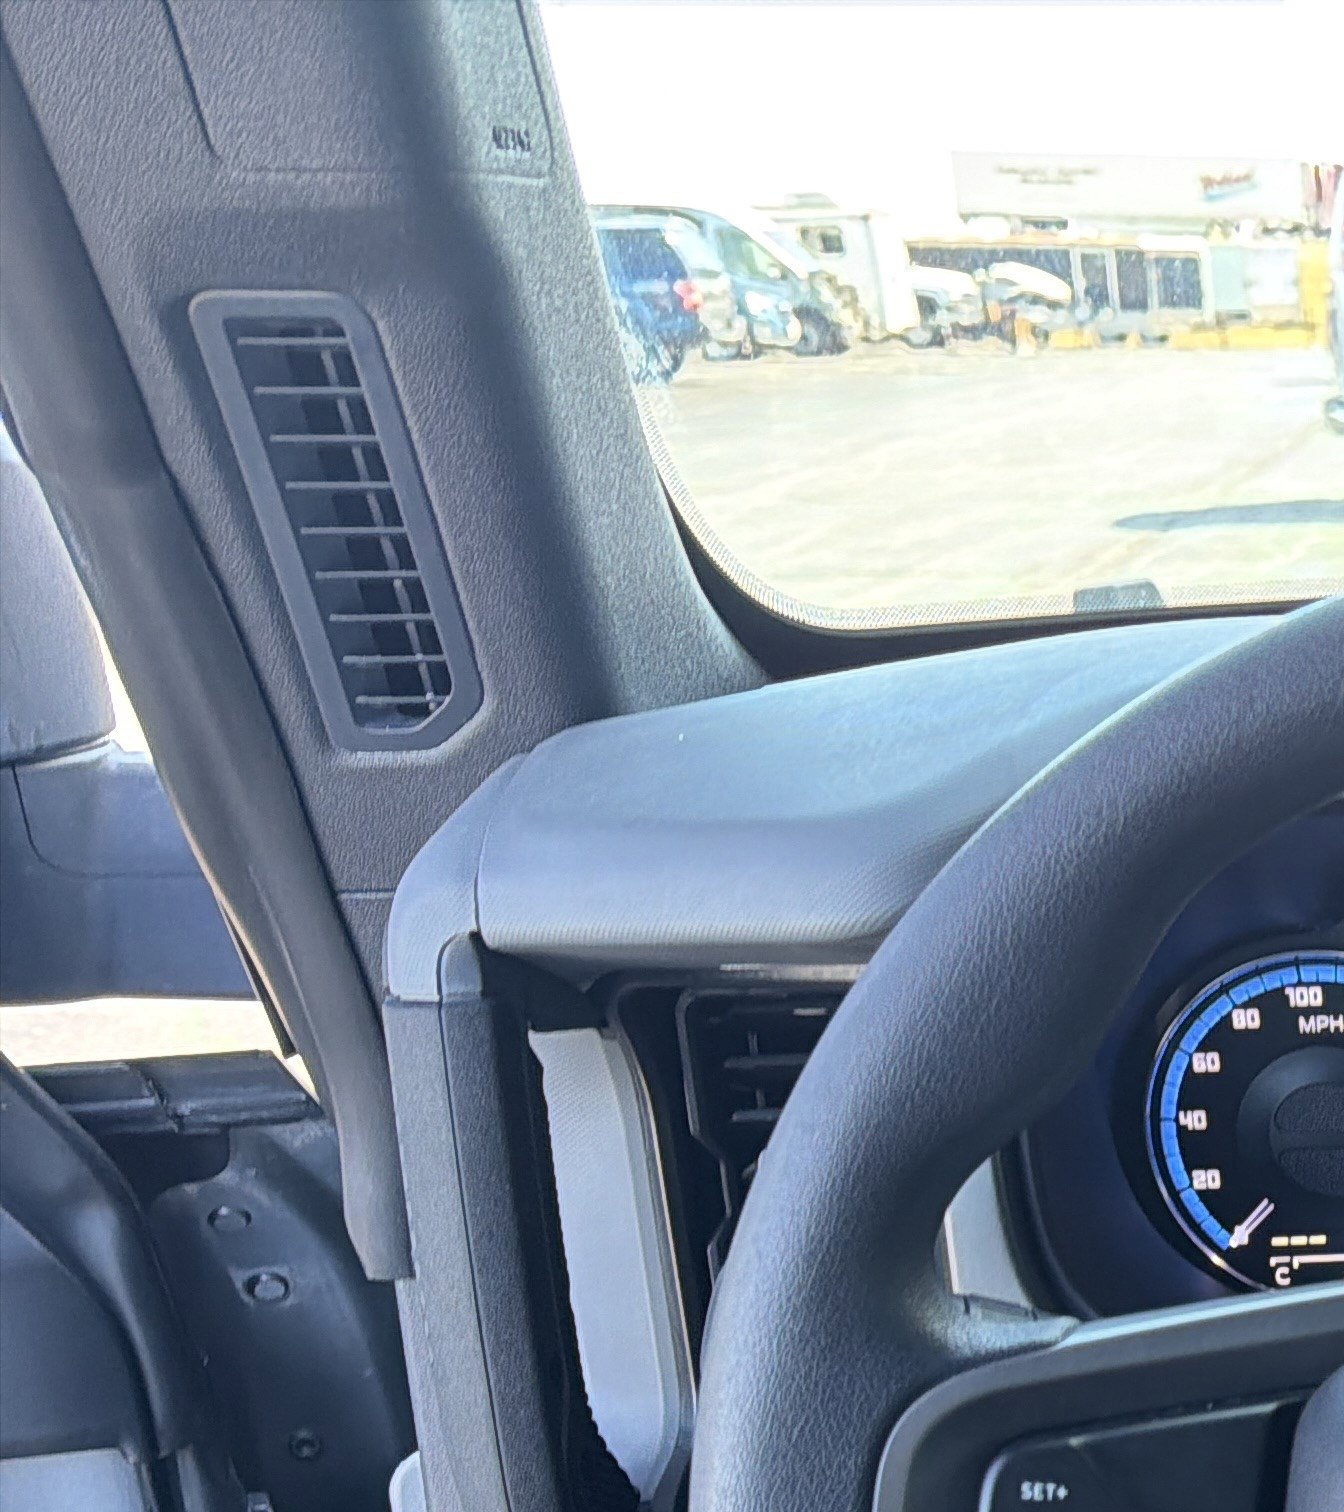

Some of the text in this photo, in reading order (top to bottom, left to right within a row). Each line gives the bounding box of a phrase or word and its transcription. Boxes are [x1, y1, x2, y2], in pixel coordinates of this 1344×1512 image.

[1285, 986, 1323, 1007] 100
[1232, 1008, 1261, 1029] 80
[1299, 1014, 1344, 1034] MPH
[1192, 1052, 1221, 1073] 60
[1179, 1110, 1207, 1131] 40
[1192, 1169, 1221, 1190] 20
[1275, 1267, 1291, 1286] C
[1021, 1481, 1068, 1501] SET+
